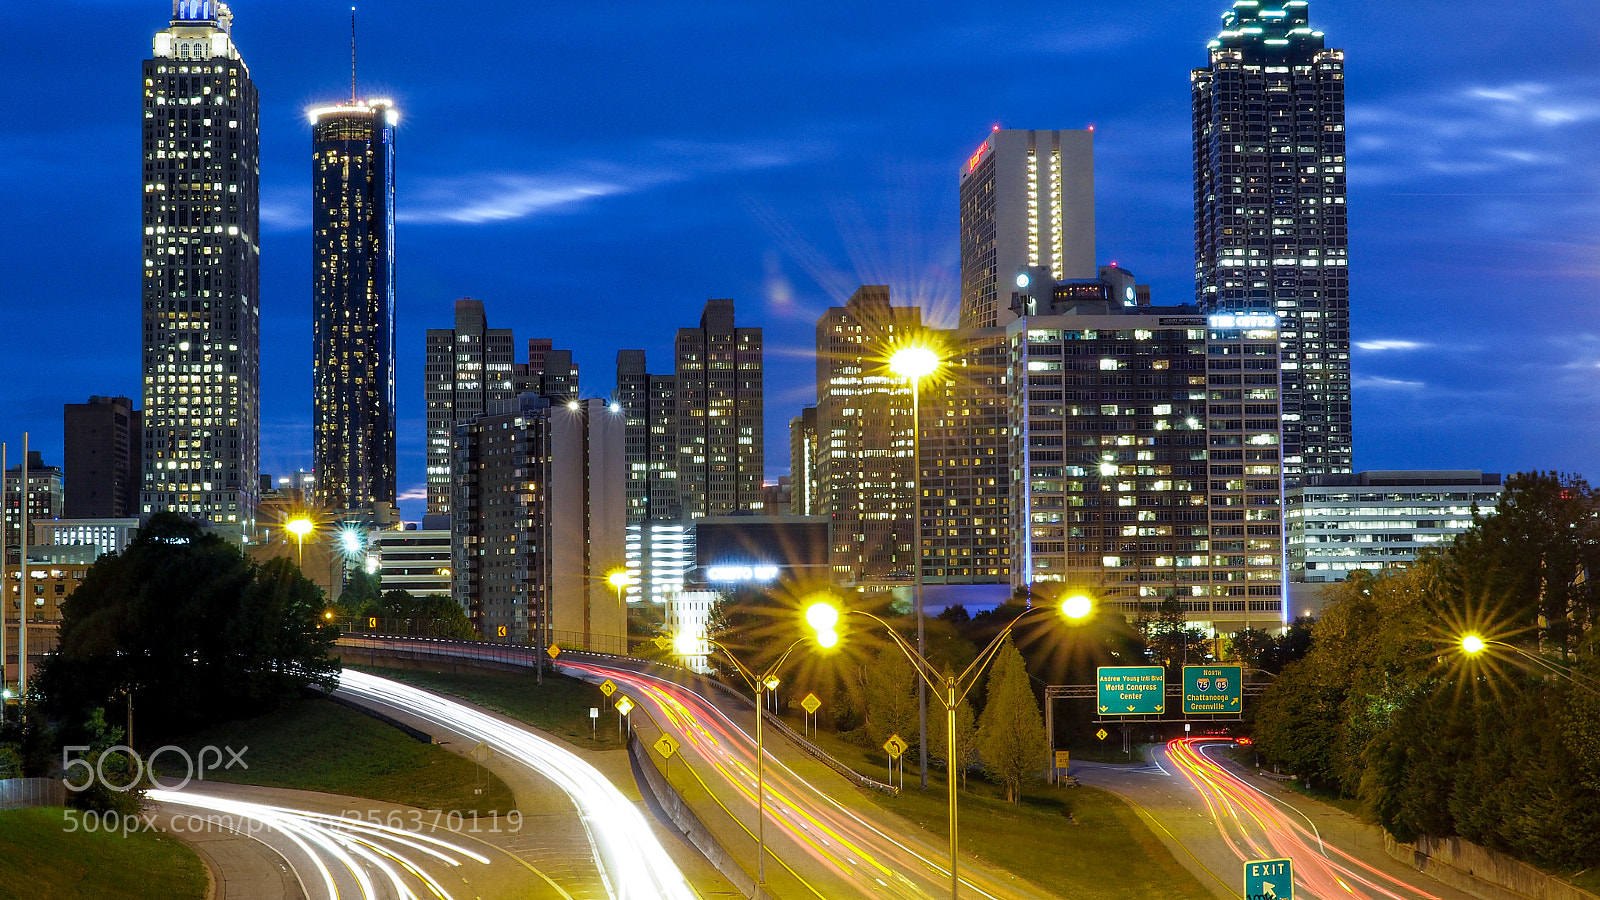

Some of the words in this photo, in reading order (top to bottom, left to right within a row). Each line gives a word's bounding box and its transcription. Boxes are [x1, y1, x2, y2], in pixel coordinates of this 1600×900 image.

[1126, 684, 1157, 692] Congress
[1199, 681, 1208, 689] 75
[1217, 681, 1227, 689] 85
[1186, 694, 1229, 703] Chattanooga
[1252, 863, 1284, 876] EXIT
